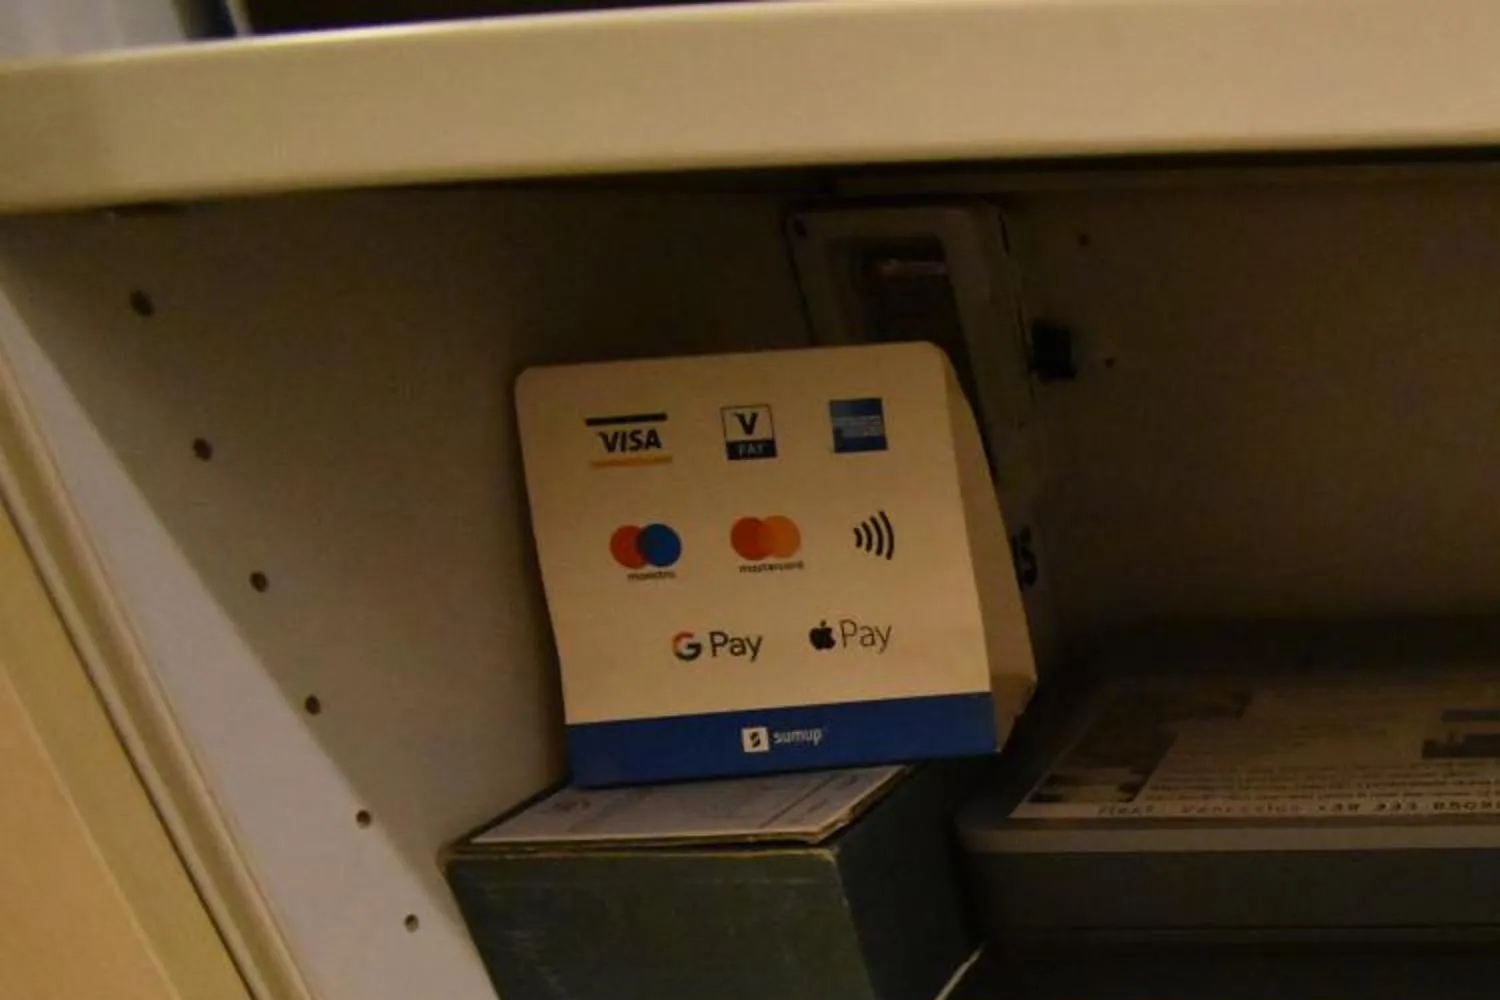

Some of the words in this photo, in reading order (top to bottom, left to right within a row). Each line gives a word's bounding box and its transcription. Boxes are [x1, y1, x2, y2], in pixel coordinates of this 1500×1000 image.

[733, 412, 759, 436] V
[598, 427, 662, 454] VISA
[708, 631, 764, 662] Pay
[839, 618, 893, 654] Pay
